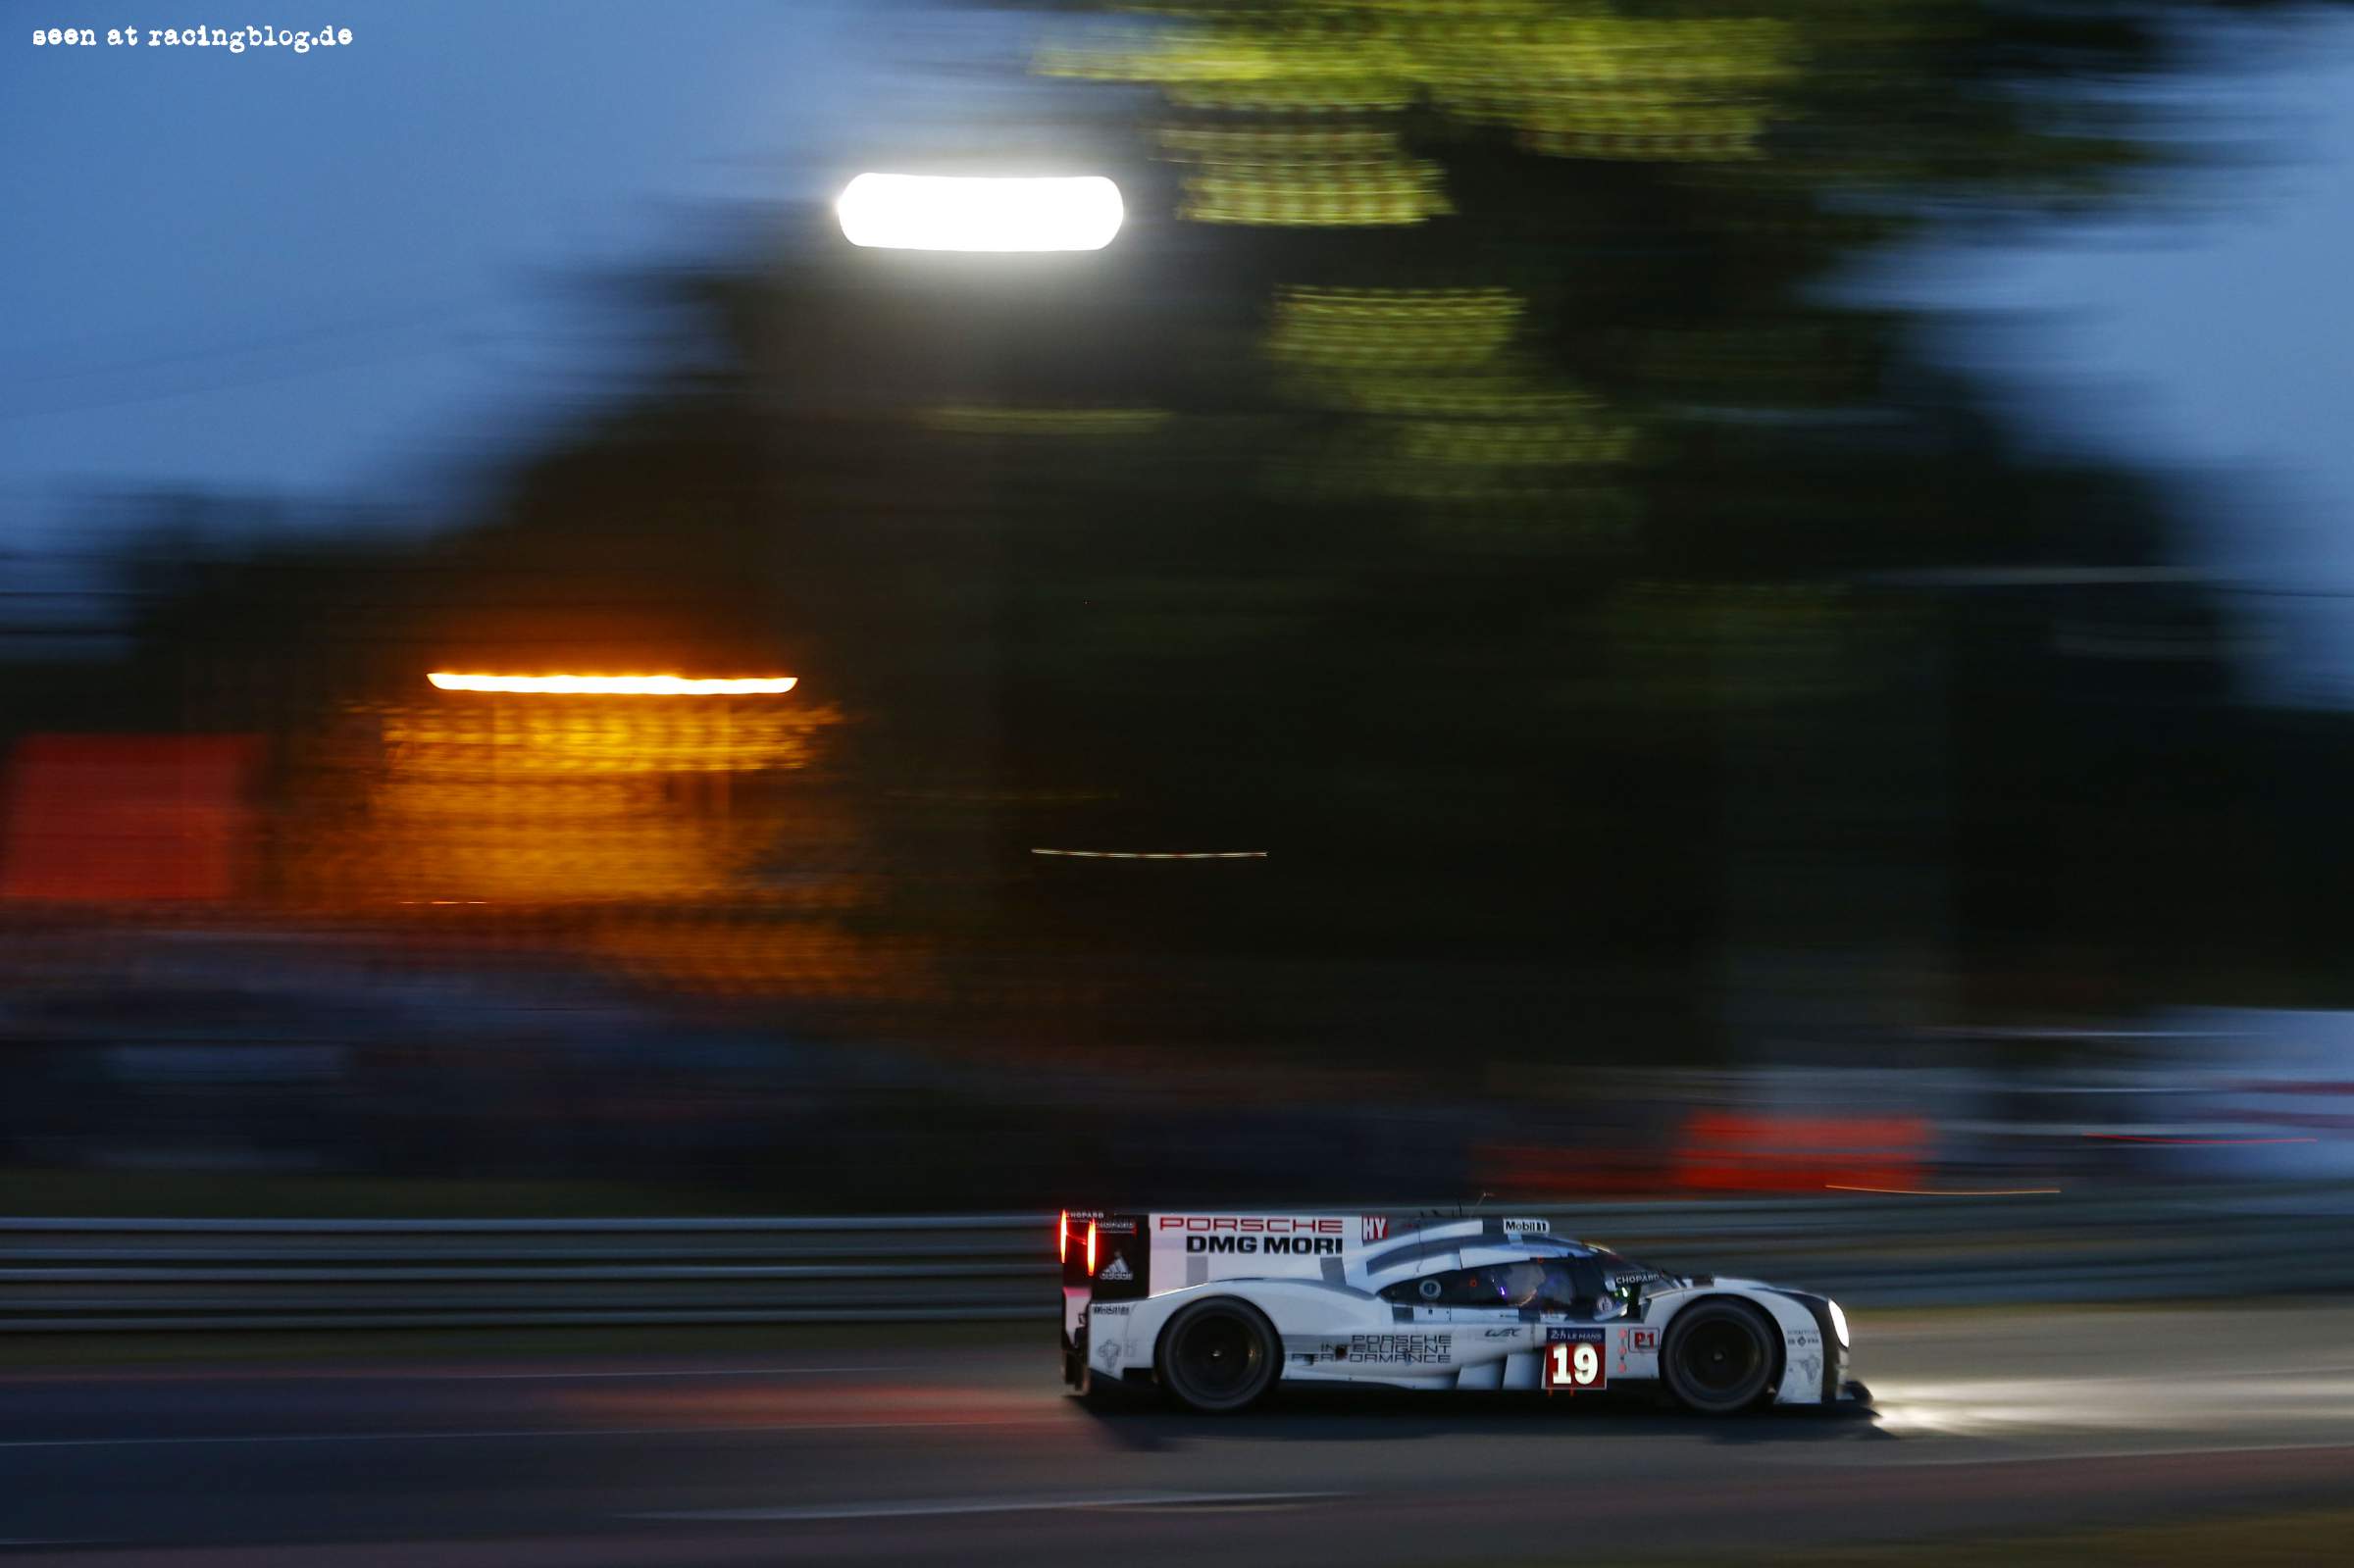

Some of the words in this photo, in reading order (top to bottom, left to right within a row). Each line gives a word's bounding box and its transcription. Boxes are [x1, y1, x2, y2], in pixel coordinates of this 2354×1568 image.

[1159, 1217, 1343, 1233] PORSCHE
[1362, 1218, 1387, 1239] HY
[1506, 1221, 1535, 1232] Mobil
[1186, 1236, 1257, 1253] DMG
[1263, 1237, 1343, 1254] MORI
[1615, 1274, 1660, 1285] CHOPARD
[1352, 1335, 1452, 1344] PORSCHE
[1634, 1332, 1655, 1350] P1
[1553, 1342, 1599, 1386] 19
